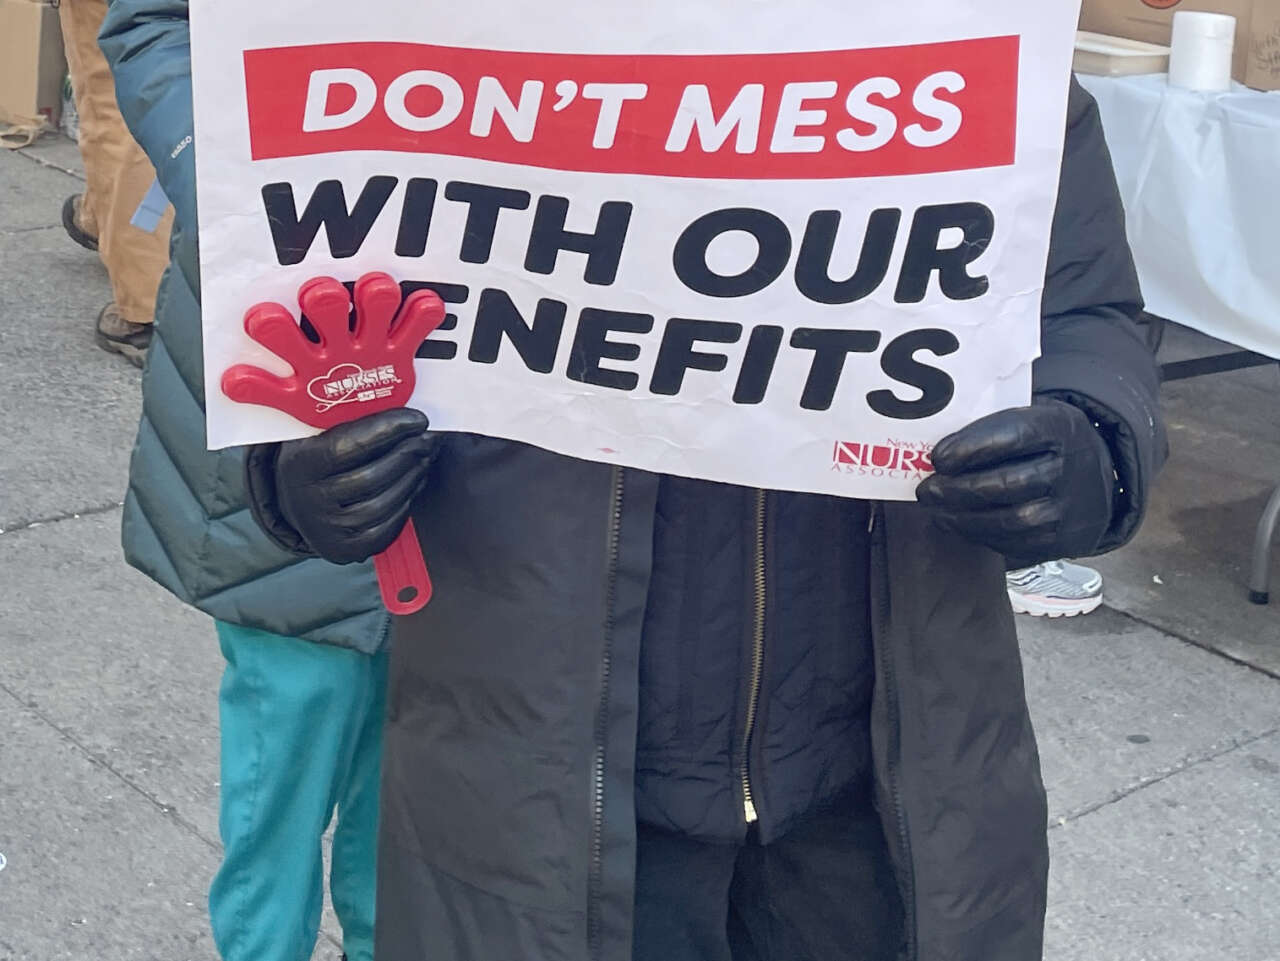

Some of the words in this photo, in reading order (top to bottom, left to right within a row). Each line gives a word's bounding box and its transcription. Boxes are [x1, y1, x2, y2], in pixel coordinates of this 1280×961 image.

[302, 67, 649, 150] DON'T
[664, 71, 967, 155] MESS
[260, 175, 634, 287] WITH
[673, 201, 996, 306] OUR
[300, 280, 961, 420] ENEFITS
[323, 366, 396, 396] NURSES
[886, 438, 916, 451] New
